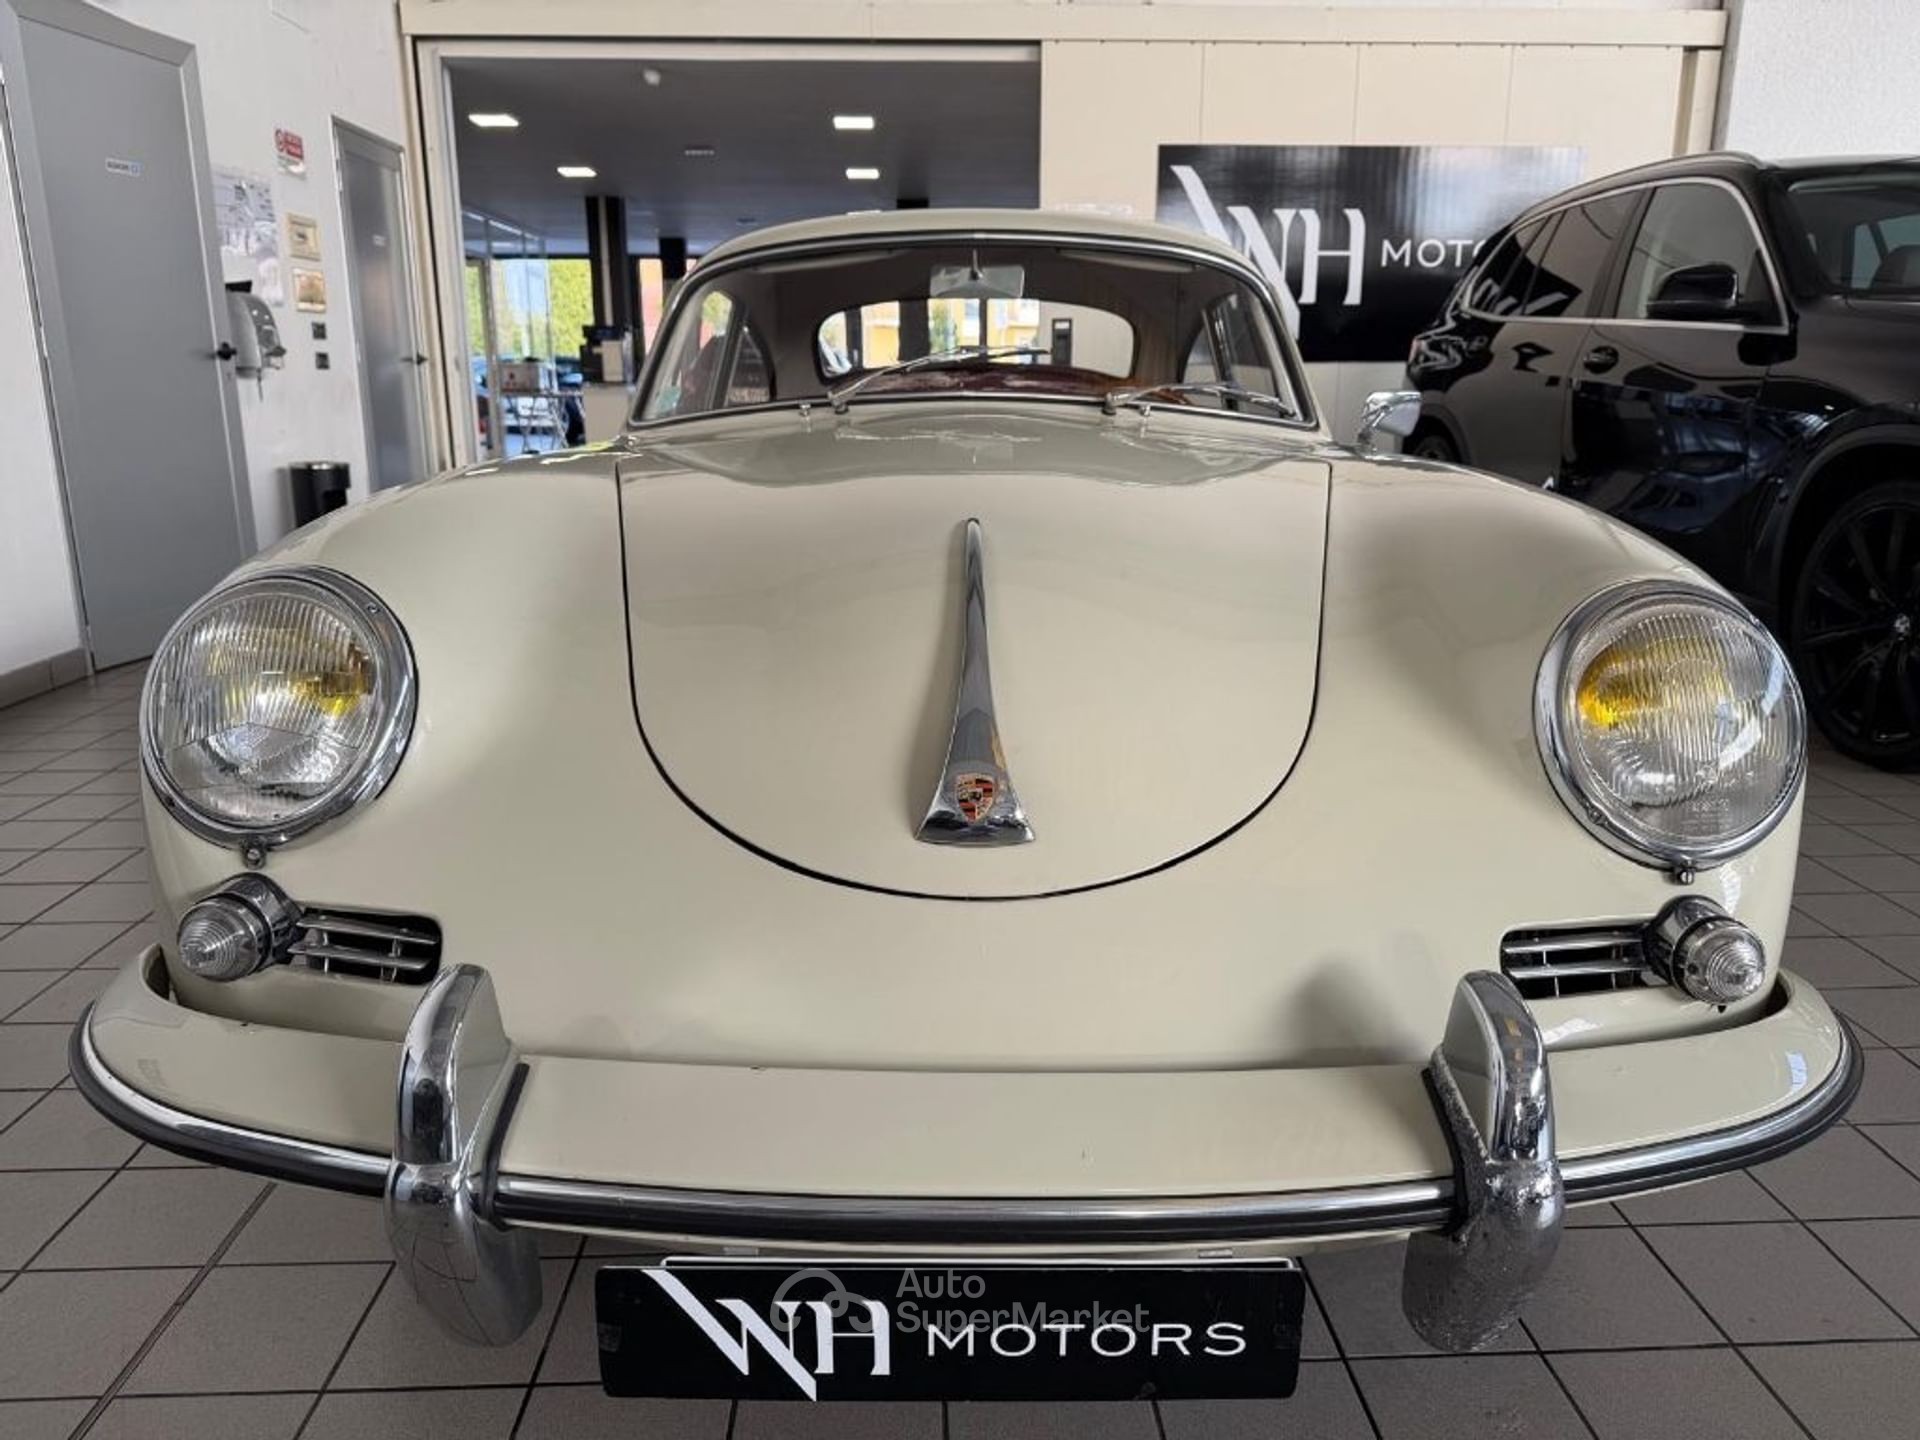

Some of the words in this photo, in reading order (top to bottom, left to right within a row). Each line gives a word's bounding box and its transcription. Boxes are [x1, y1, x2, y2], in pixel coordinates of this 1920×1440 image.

[1381, 239, 1486, 268] MOT
[640, 1269, 891, 1402] WH
[927, 1321, 1248, 1358] MOTORS
